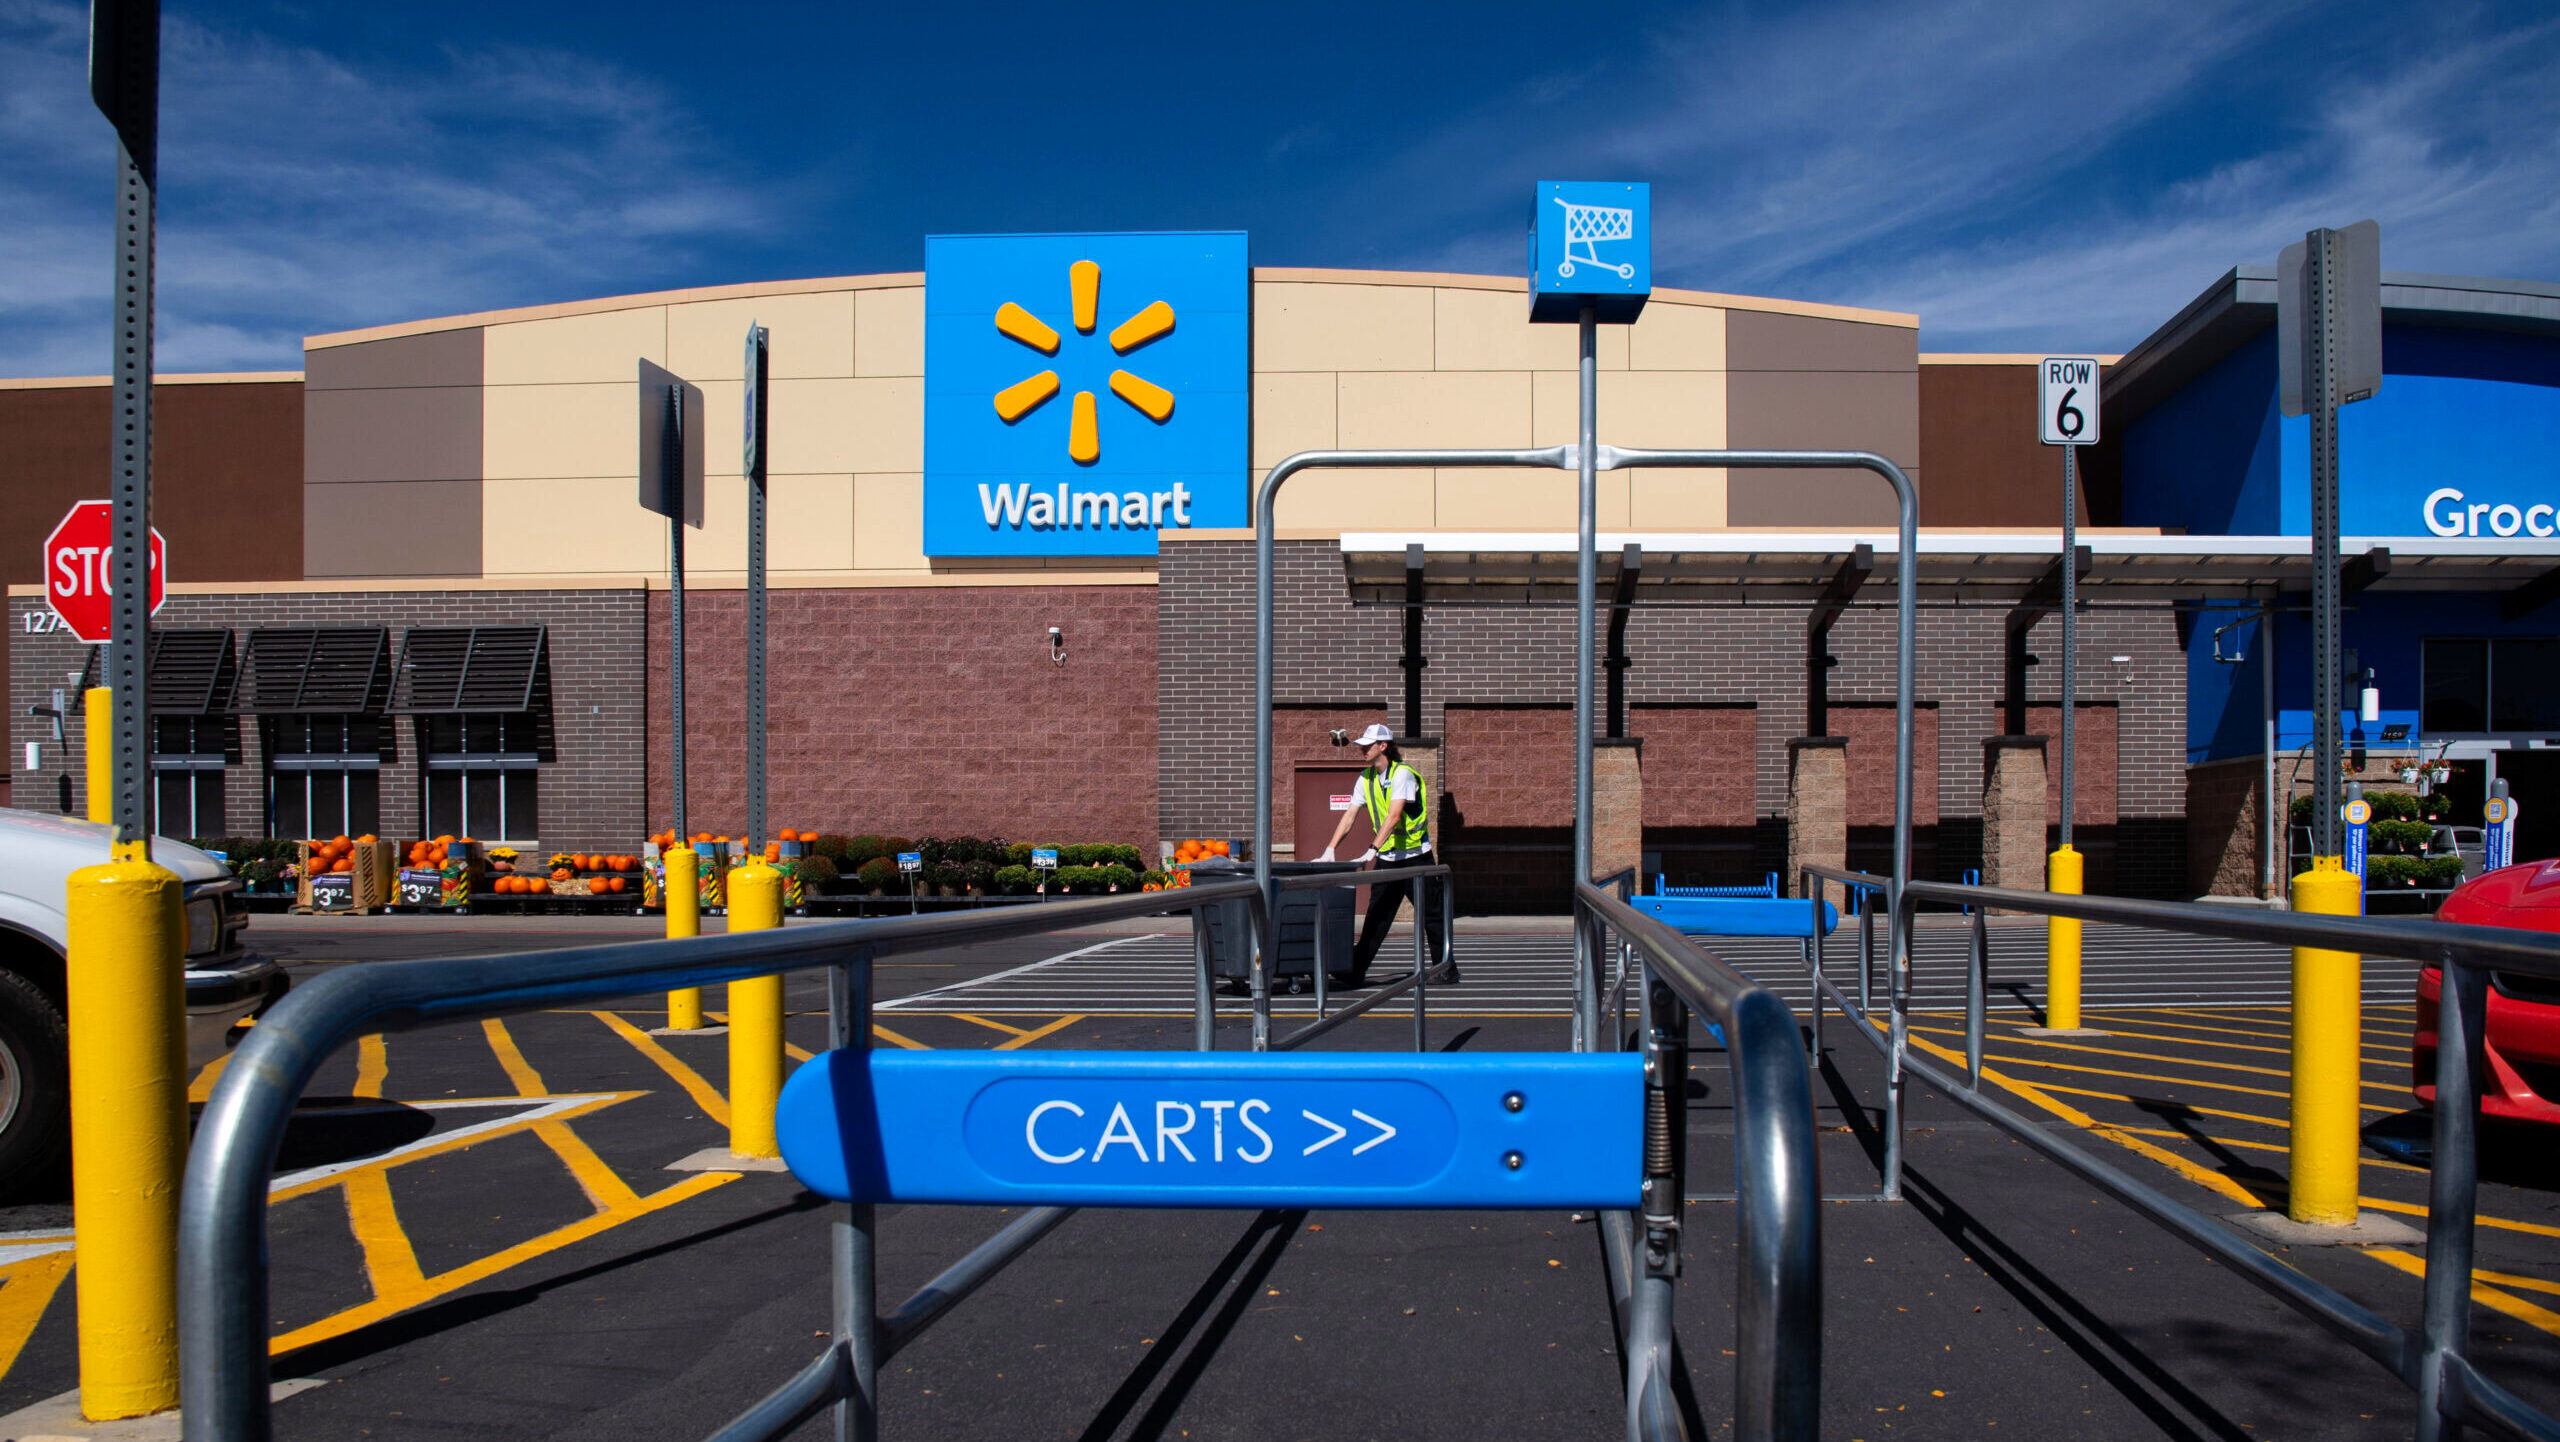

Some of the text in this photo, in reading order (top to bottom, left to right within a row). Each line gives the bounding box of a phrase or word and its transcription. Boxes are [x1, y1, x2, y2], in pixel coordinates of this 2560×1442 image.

[2050, 363, 2091, 385] ROW
[2057, 387, 2085, 439] 6
[977, 482, 1192, 528] Walmart
[2423, 487, 2560, 537] Groc
[54, 546, 157, 598] ST
[1026, 1098, 1274, 1164] CARTS
